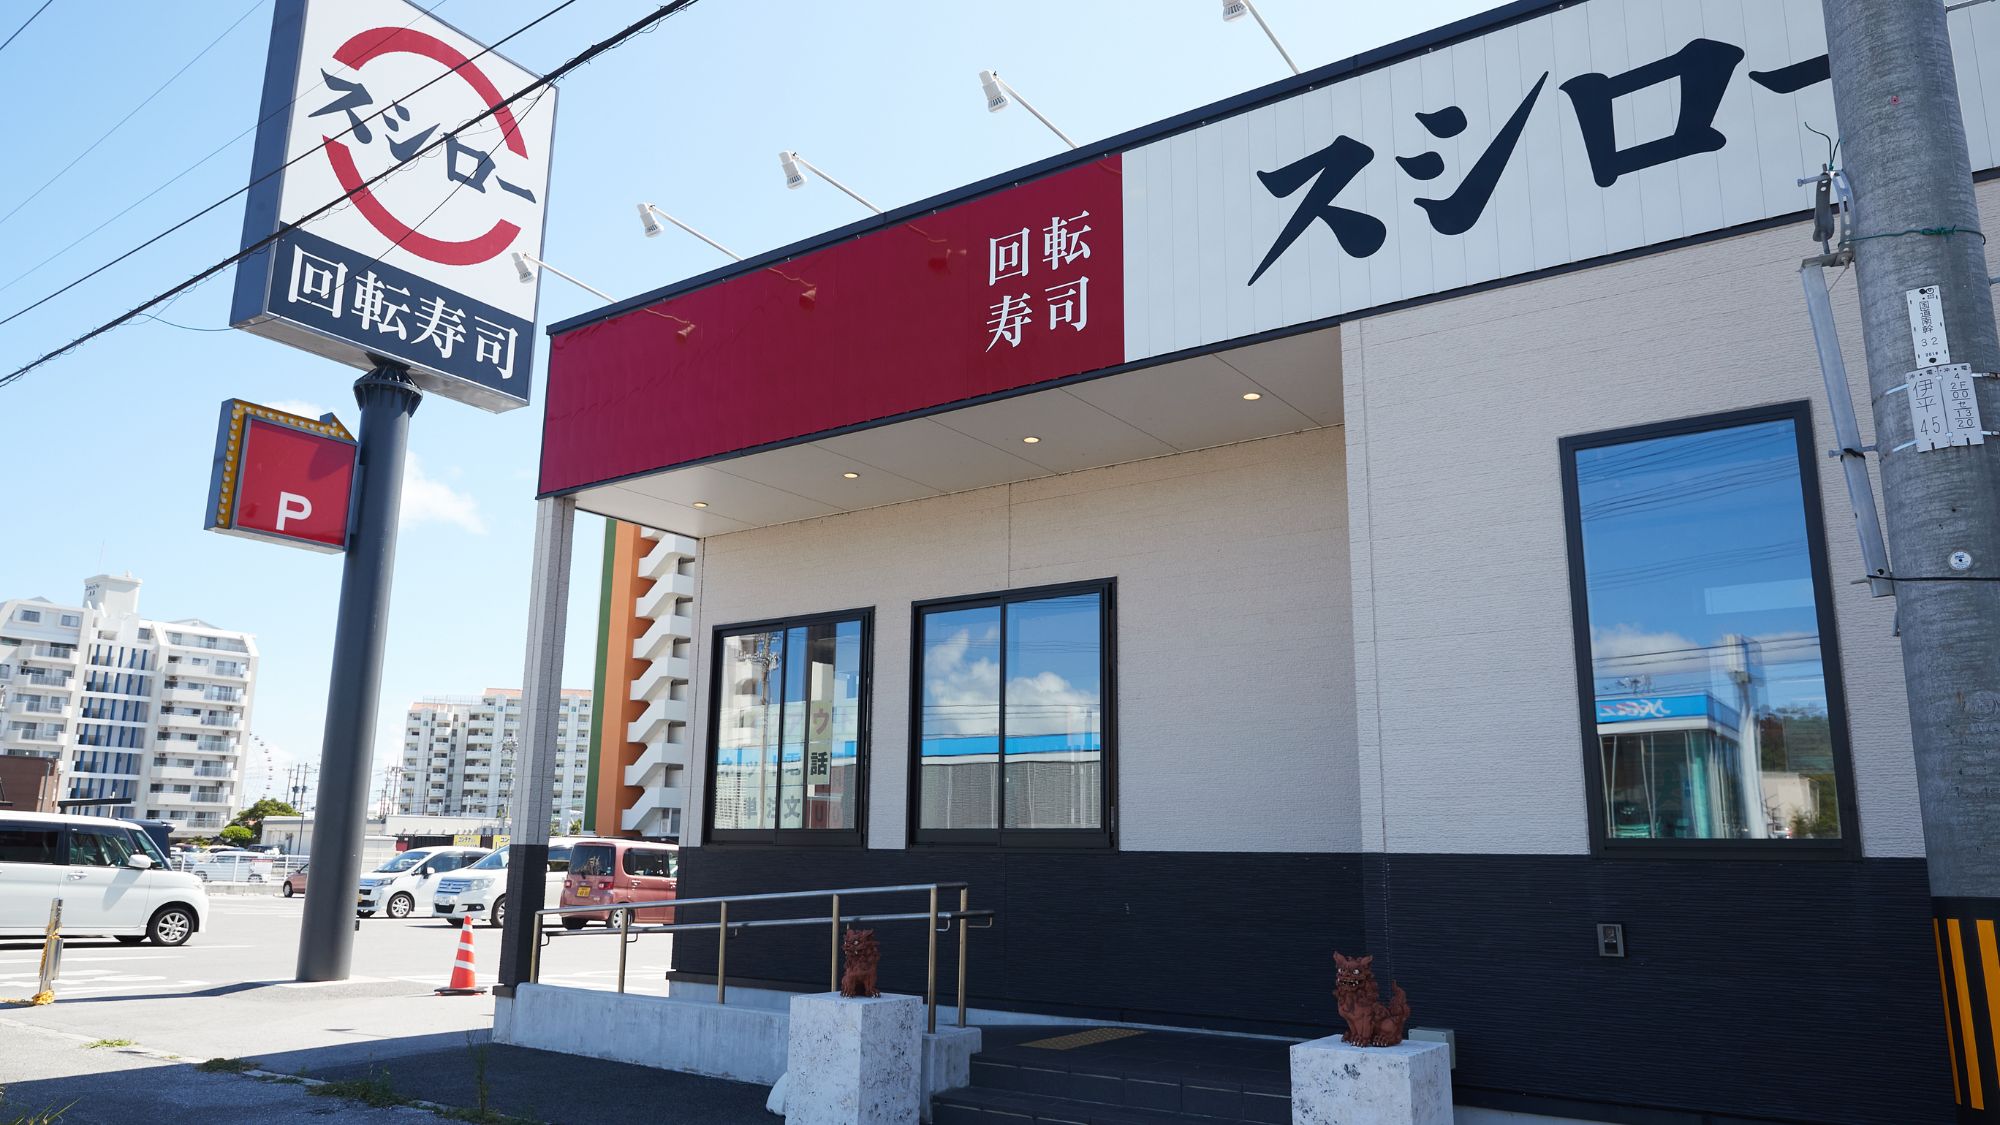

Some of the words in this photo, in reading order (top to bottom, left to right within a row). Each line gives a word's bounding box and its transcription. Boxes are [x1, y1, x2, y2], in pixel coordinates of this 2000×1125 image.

[308, 67, 537, 204] スシロー
[989, 210, 1092, 287] 回転
[287, 244, 519, 380] 回転寿司
[985, 275, 1089, 353] 寿司
[1921, 336, 1939, 347] 32
[1950, 381, 1967, 390] 2F
[1954, 372, 1960, 380] 4
[1913, 379, 1936, 413] 伊平
[1920, 416, 1940, 436] 45
[1956, 409, 1972, 418] 13
[1957, 418, 1974, 428] 20
[275, 491, 312, 531] P
